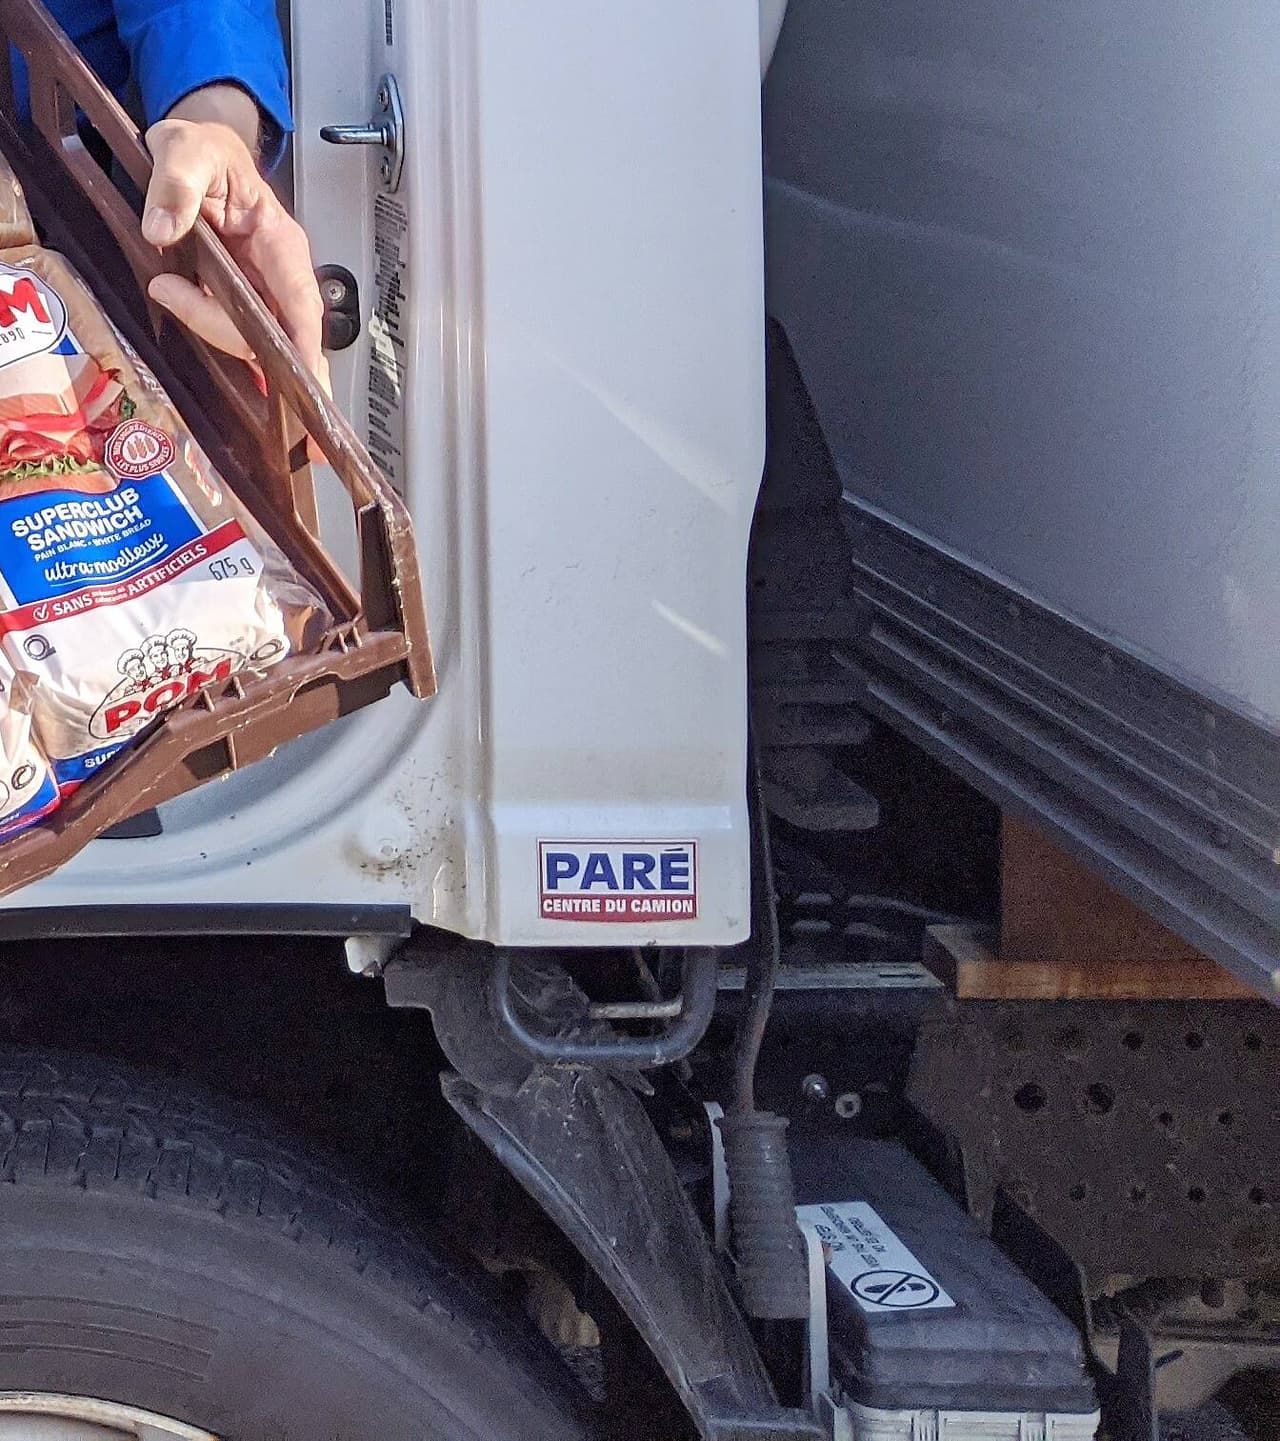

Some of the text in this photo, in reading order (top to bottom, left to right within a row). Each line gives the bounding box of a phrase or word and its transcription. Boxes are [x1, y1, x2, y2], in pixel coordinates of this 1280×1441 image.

[11, 487, 140, 538] SUPERCLUB
[28, 506, 143, 551] SANDWICH
[34, 519, 152, 562] PAIN BLANC WHITE BREAD
[44, 533, 168, 586] ultra-moelleux
[53, 544, 207, 616] SANS ARTIFICIELS
[208, 557, 238, 581] 675
[546, 848, 689, 890] PARÉ
[543, 898, 693, 912] CENTRE DU CAMION
